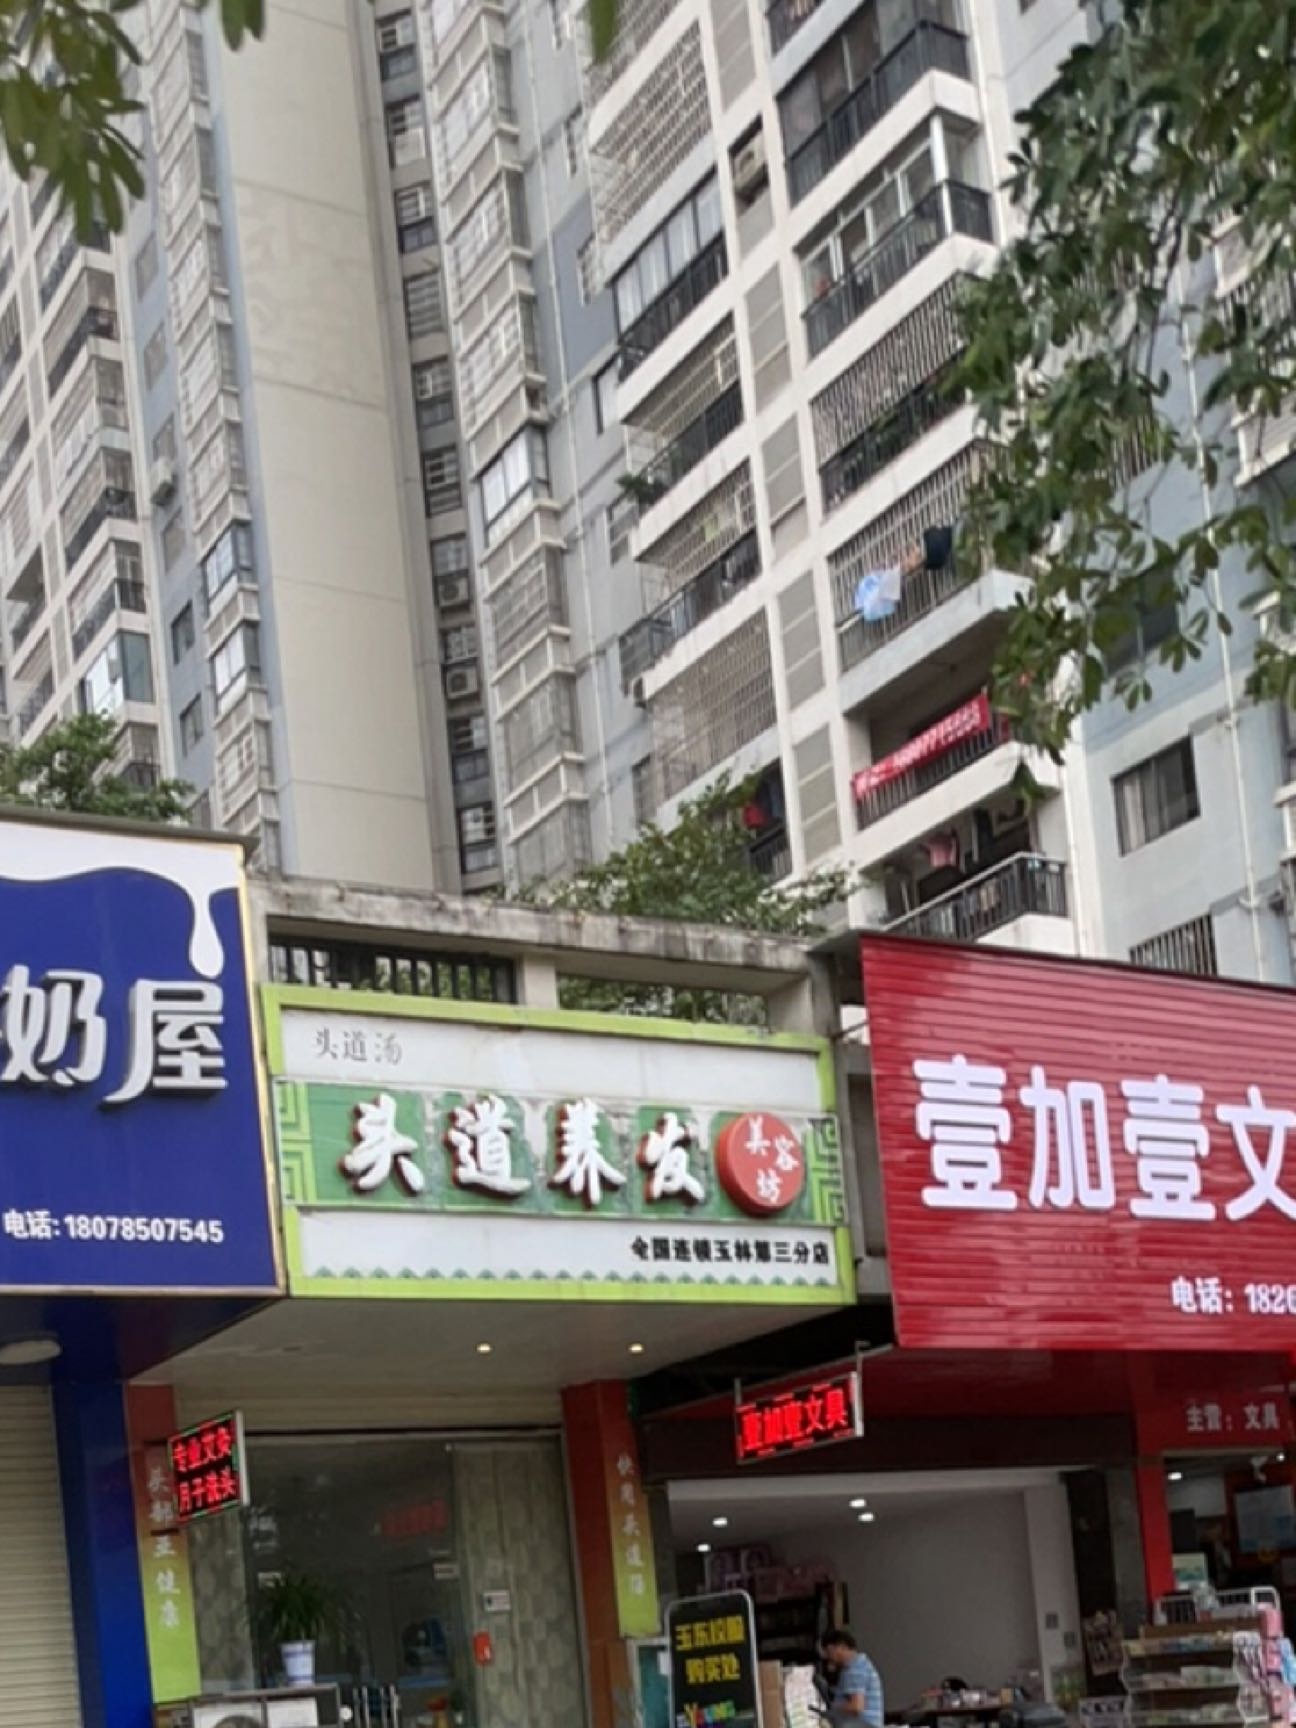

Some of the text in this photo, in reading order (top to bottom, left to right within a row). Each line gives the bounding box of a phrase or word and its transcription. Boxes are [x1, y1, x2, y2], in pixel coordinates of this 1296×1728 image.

[313, 1026, 403, 1066] 头道汤
[340, 1093, 706, 1208] 头道养发
[912, 1054, 1296, 1222] 壹加壹文
